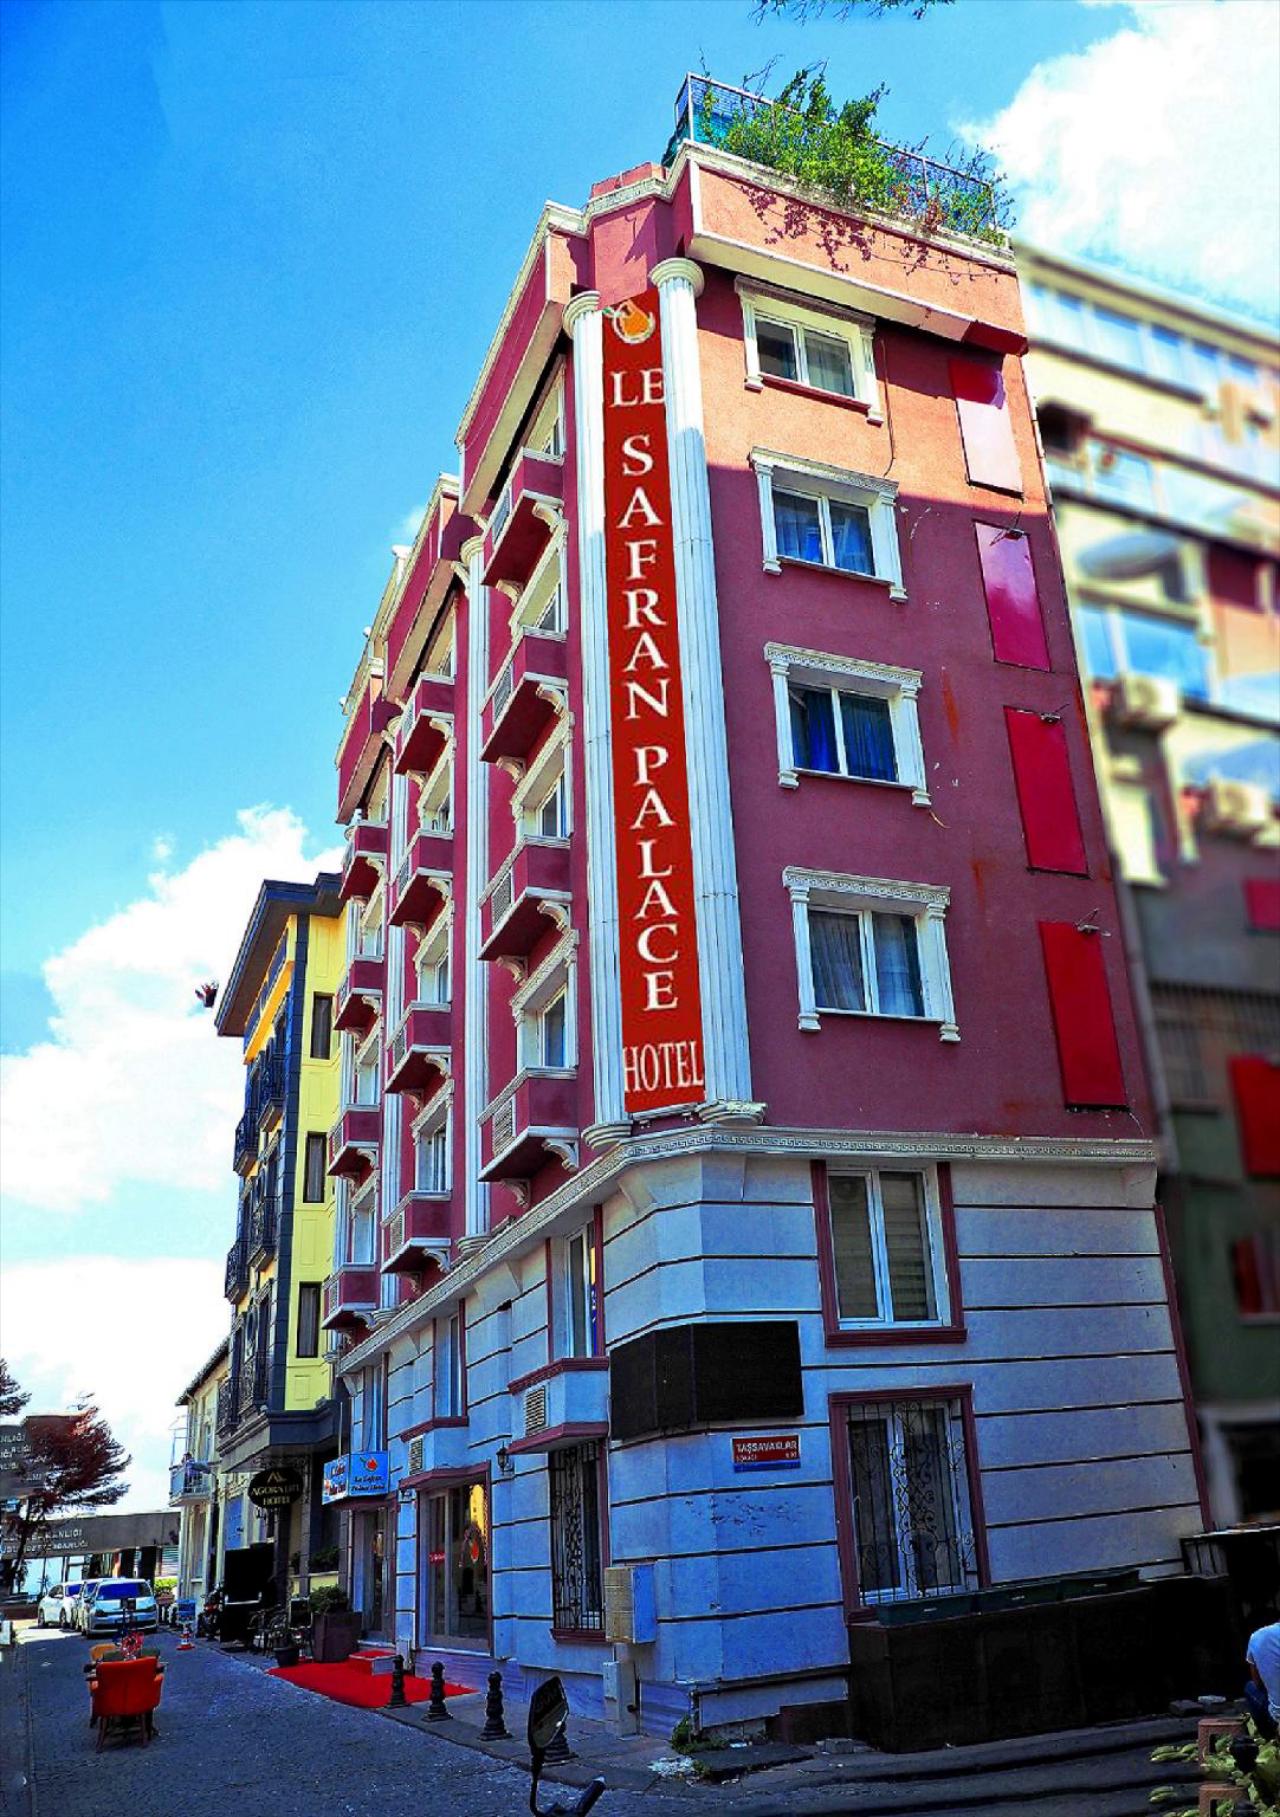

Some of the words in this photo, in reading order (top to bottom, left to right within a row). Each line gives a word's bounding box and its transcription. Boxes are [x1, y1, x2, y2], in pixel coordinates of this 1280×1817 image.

[609, 368, 664, 408] LE
[616, 434, 670, 720] SAFRAN
[629, 745, 679, 1012] PALACE
[622, 1041, 704, 1093] HOTEL
